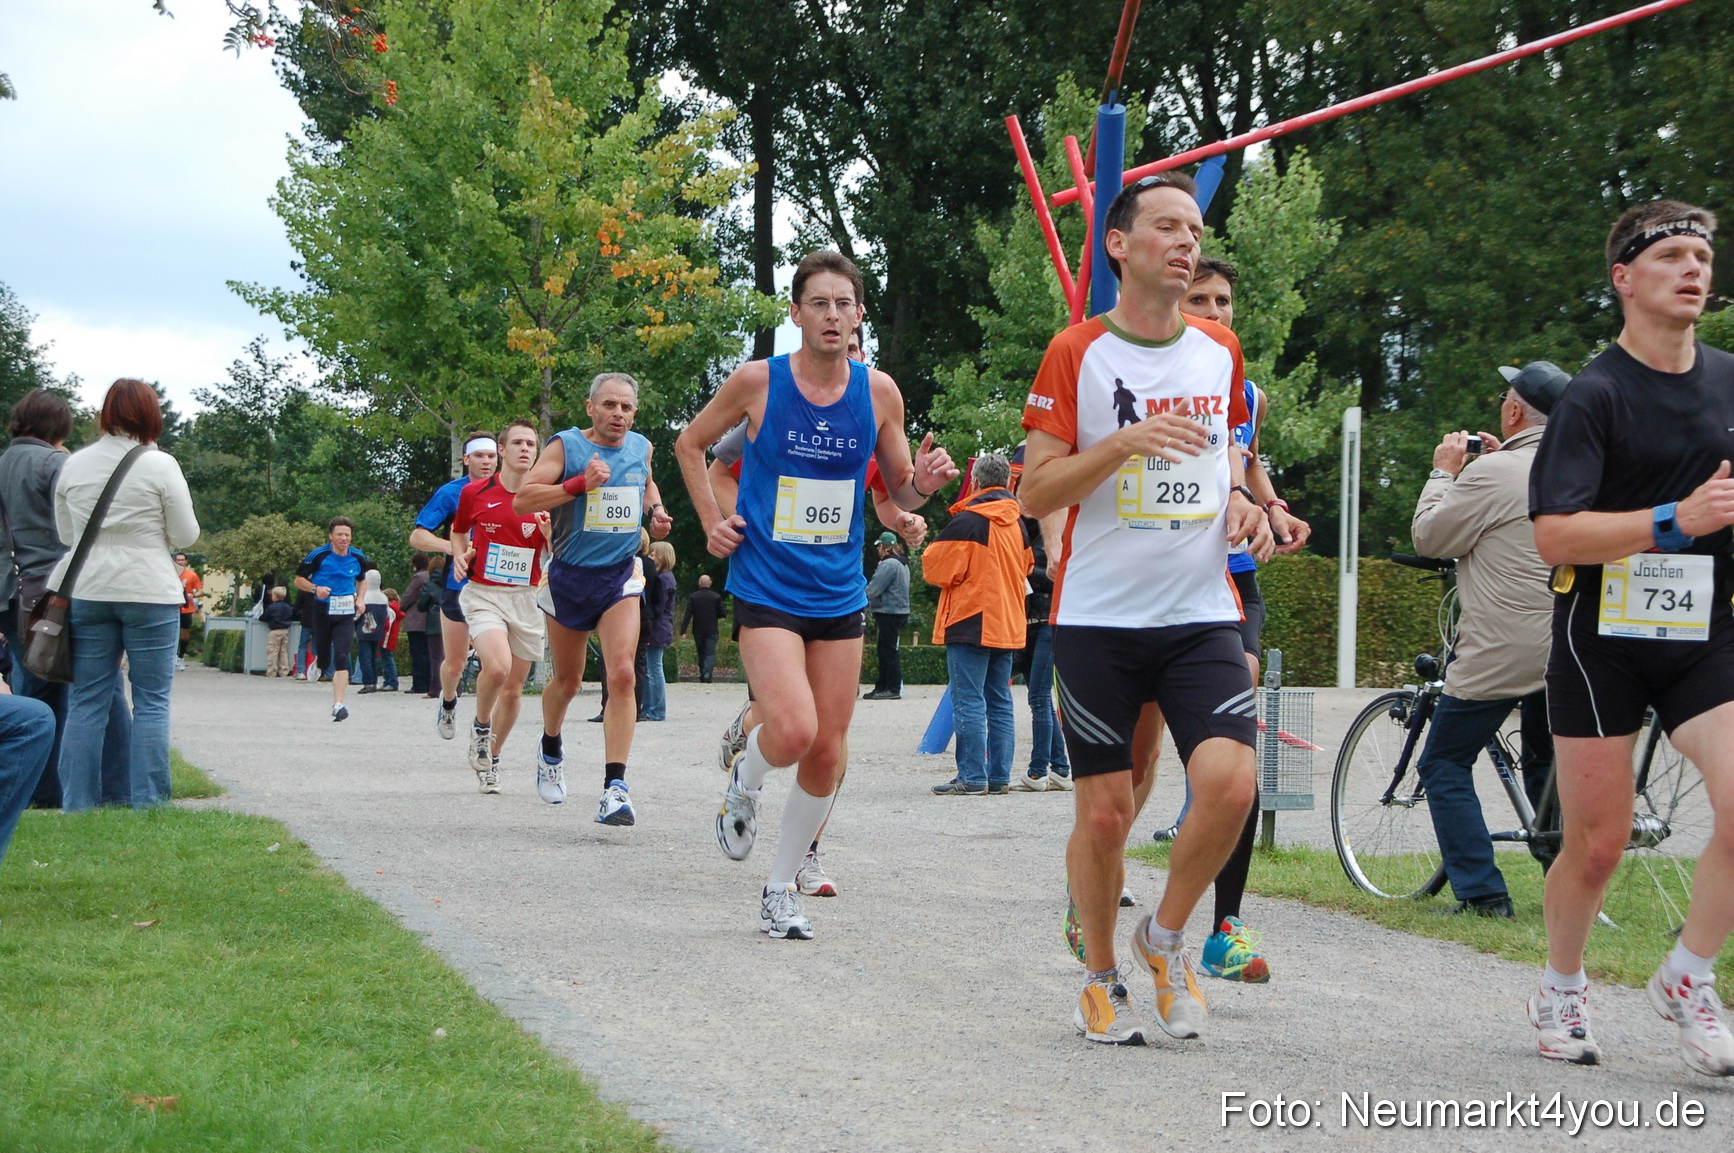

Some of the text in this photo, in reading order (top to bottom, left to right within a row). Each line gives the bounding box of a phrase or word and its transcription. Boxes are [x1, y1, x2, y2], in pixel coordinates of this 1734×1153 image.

[788, 430, 857, 449] ELOTEC
[602, 492, 618, 501] Alois
[1122, 479, 1201, 504] A 282
[606, 505, 631, 519] 890
[805, 506, 841, 524] 965
[501, 548, 520, 558] Stefan
[500, 559, 527, 572] 2018
[1633, 562, 1683, 579] Jochen
[1606, 584, 1693, 612] A 734
